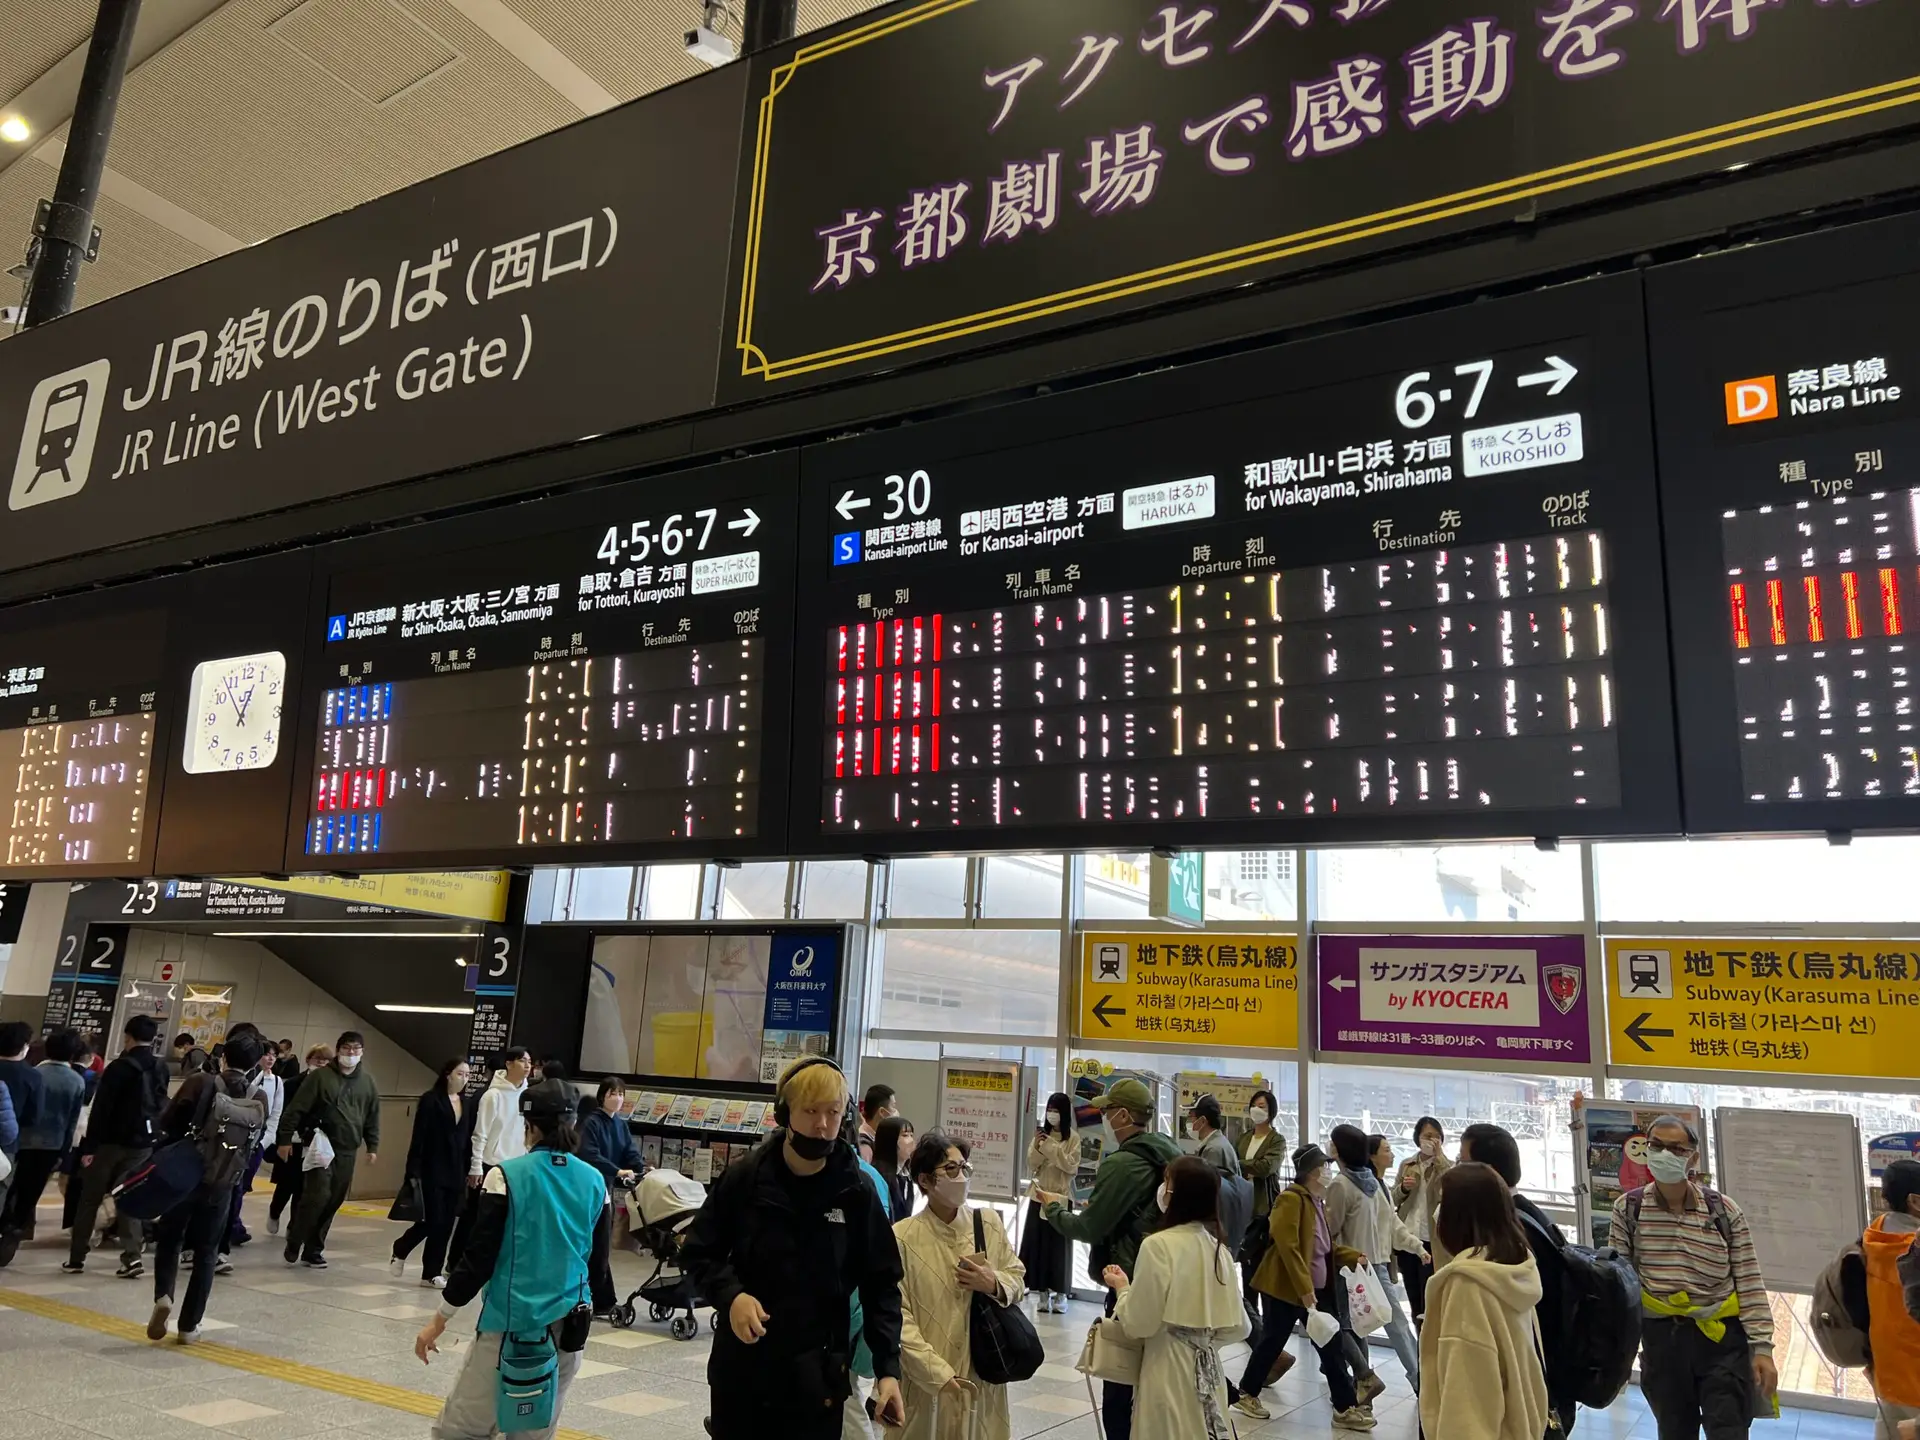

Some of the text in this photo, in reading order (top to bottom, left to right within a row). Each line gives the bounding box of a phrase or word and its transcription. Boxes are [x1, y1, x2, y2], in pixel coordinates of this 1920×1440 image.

[984, 0, 1394, 132] アクセス
[812, 0, 1890, 291] 京都劇場で感動を
[1787, 357, 1888, 396] 奈良線
[112, 314, 533, 480] JR Line (West Gate)
[1735, 384, 1769, 418] D
[1790, 386, 1902, 416] Nara Line
[1470, 420, 1572, 451] 特急 くろしお
[1244, 434, 1452, 489] 和歌山・白浜 方面
[1479, 441, 1567, 468] KUROSHIO
[882, 469, 932, 521] 30
[1168, 481, 1209, 501] はるか
[1245, 465, 1453, 511] for Wakayama, Shirahama
[1810, 477, 1854, 497] Type
[1542, 489, 1591, 514] のりば
[980, 493, 1116, 533] 関西空港 方面
[1140, 502, 1197, 522] HARUKA
[1547, 510, 1588, 528] Track
[865, 518, 942, 548] 関西空港線
[959, 522, 1085, 556] for Kansai-airport
[1378, 530, 1456, 551] Destination
[840, 536, 854, 561] S
[864, 538, 948, 561] Kansai-airport Line
[657, 562, 688, 584] 方面
[710, 555, 756, 574] スーパーはくと
[1181, 554, 1277, 577] Departure Time
[695, 570, 755, 589] SUPER HAKUTO
[533, 582, 561, 602] 方面
[577, 582, 686, 612] for Tottori, Kurayoshi
[1012, 582, 1073, 600] Train Name
[347, 606, 397, 628] JR京都線
[400, 623, 414, 639] for
[500, 603, 553, 624] Sannomiya
[733, 607, 760, 624] のりば
[871, 606, 894, 620] Type
[330, 618, 343, 639] A
[347, 629, 355, 640] JR
[373, 624, 388, 635] Line
[735, 623, 758, 635] Track
[643, 633, 687, 647] Destination
[533, 645, 588, 660] Departure Time
[28, 667, 46, 681] 方面
[241, 666, 255, 680] 12
[259, 670, 265, 683] 1
[434, 661, 471, 673] Train Name
[9, 683, 38, 696] Maibara
[228, 675, 239, 689] 11
[269, 682, 277, 695] 2
[347, 675, 362, 686] Type
[215, 692, 227, 705] 10
[207, 712, 216, 726] 9
[272, 705, 282, 719] 3
[210, 735, 219, 748] 8
[263, 730, 272, 743] 4
[222, 748, 231, 761] 7
[235, 752, 244, 765] 6
[249, 745, 258, 759] 5
[166, 884, 174, 897] A
[61, 934, 78, 967] 2
[90, 936, 115, 969] 2
[488, 936, 511, 978] 3
[789, 969, 812, 978] OMPU
[1264, 975, 1299, 991] Line)
[1369, 961, 1527, 985] サンガスタジアム
[1388, 989, 1509, 1010] by KYOCERA
[1877, 988, 1920, 1007] Line
